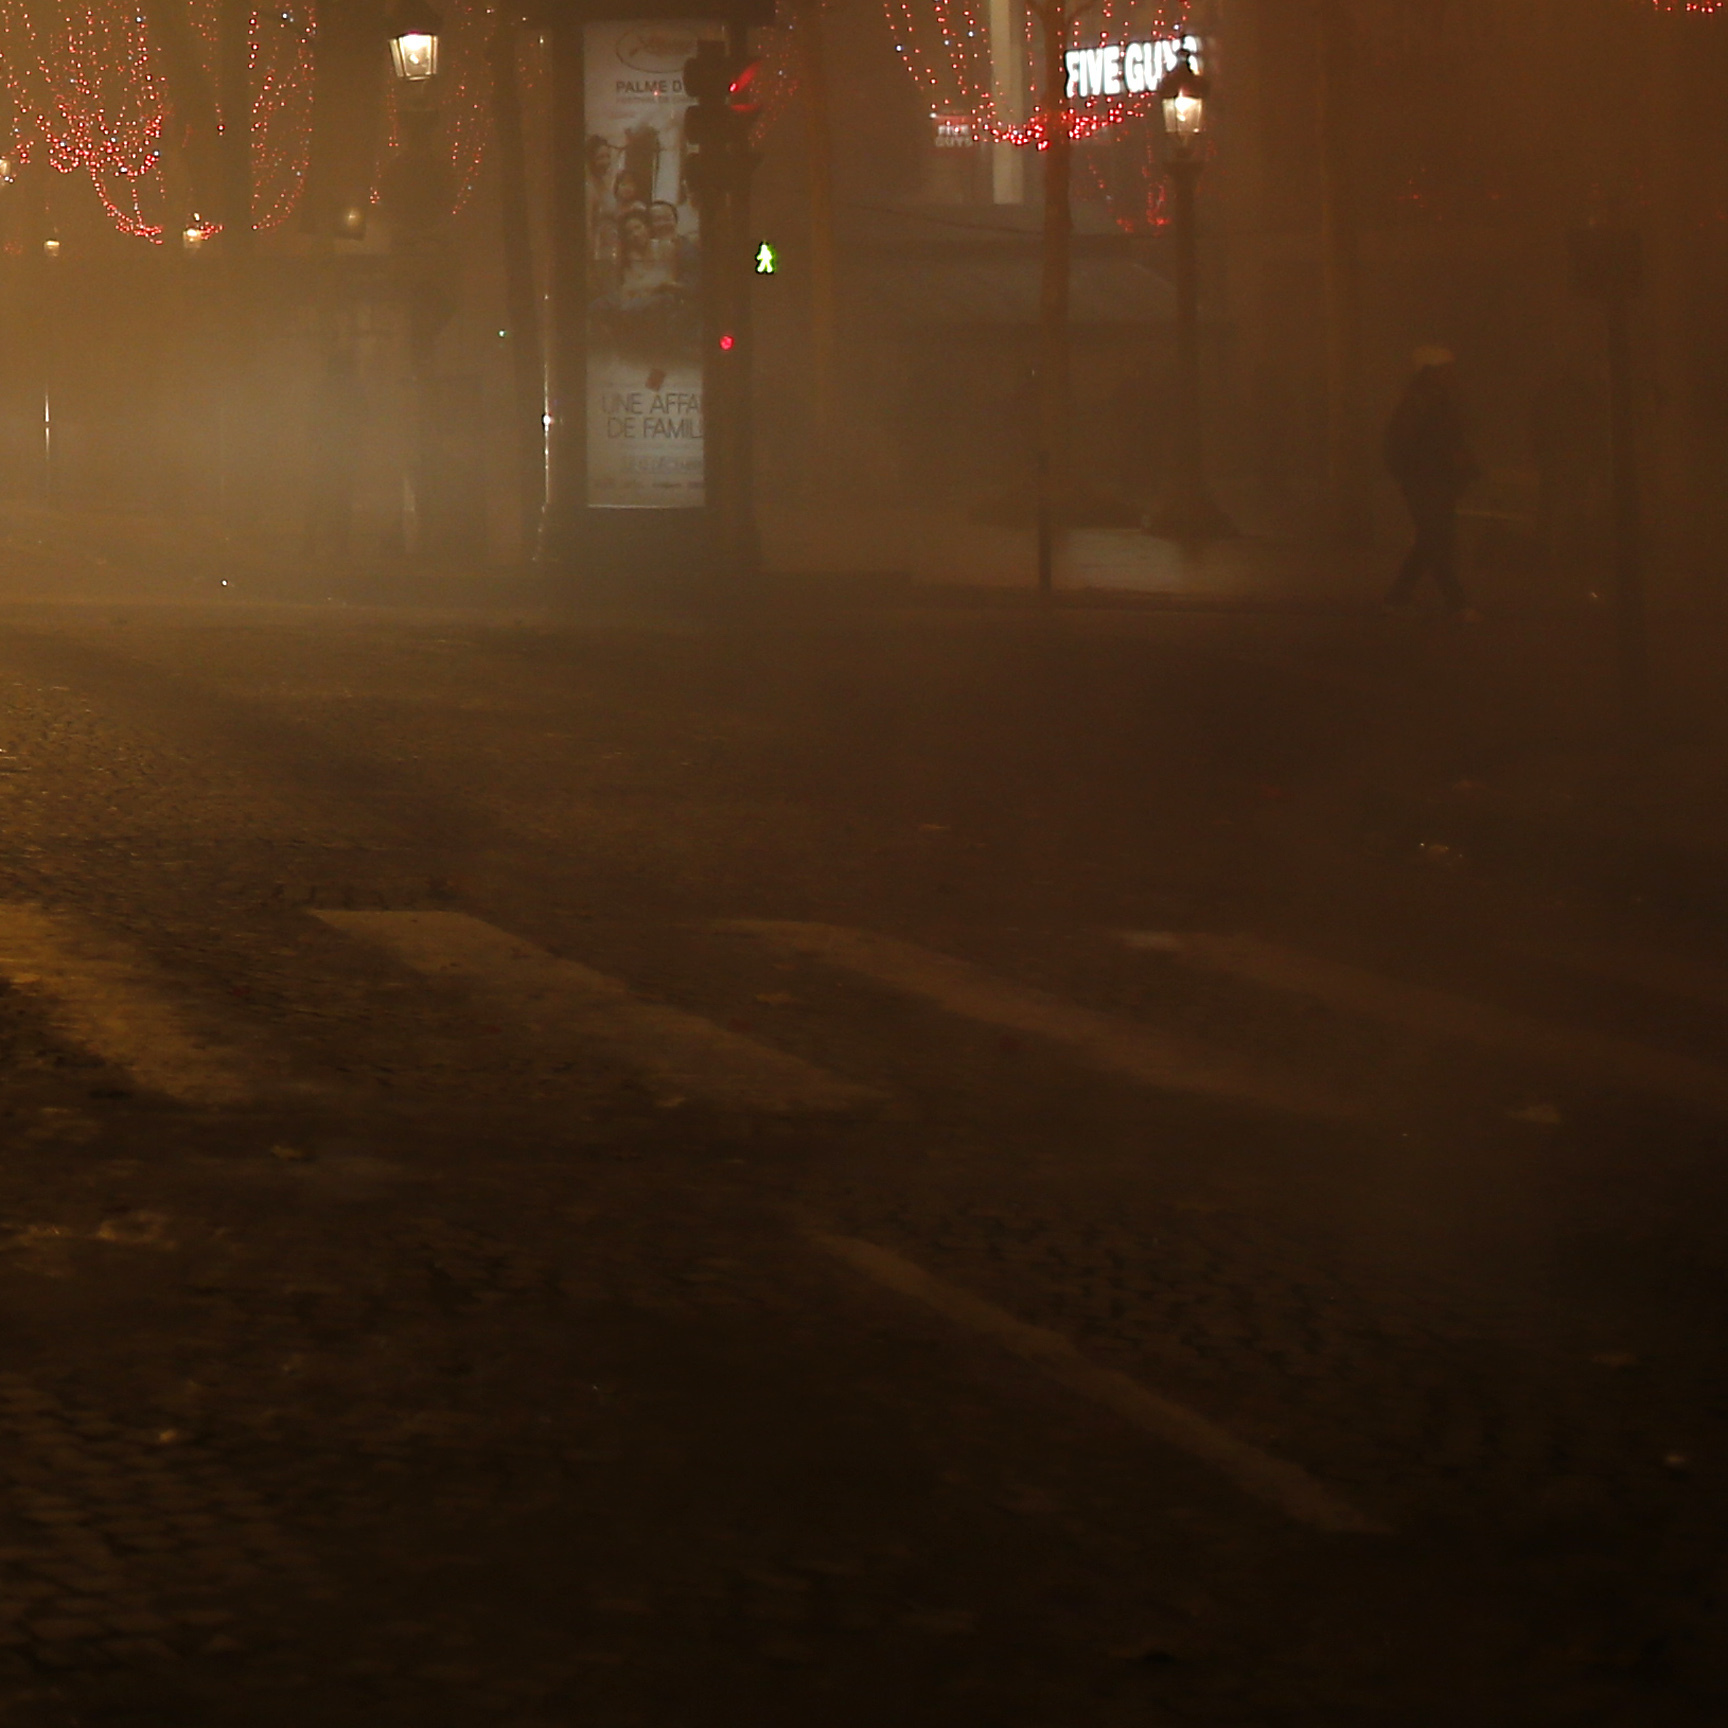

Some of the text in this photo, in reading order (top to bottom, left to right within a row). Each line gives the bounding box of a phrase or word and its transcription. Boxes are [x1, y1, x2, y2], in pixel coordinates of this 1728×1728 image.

[1065, 45, 1121, 98] FIVE
[615, 80, 667, 93] PALME
[601, 393, 701, 414] UNE AFFA
[607, 417, 703, 439] DE FAMIL
